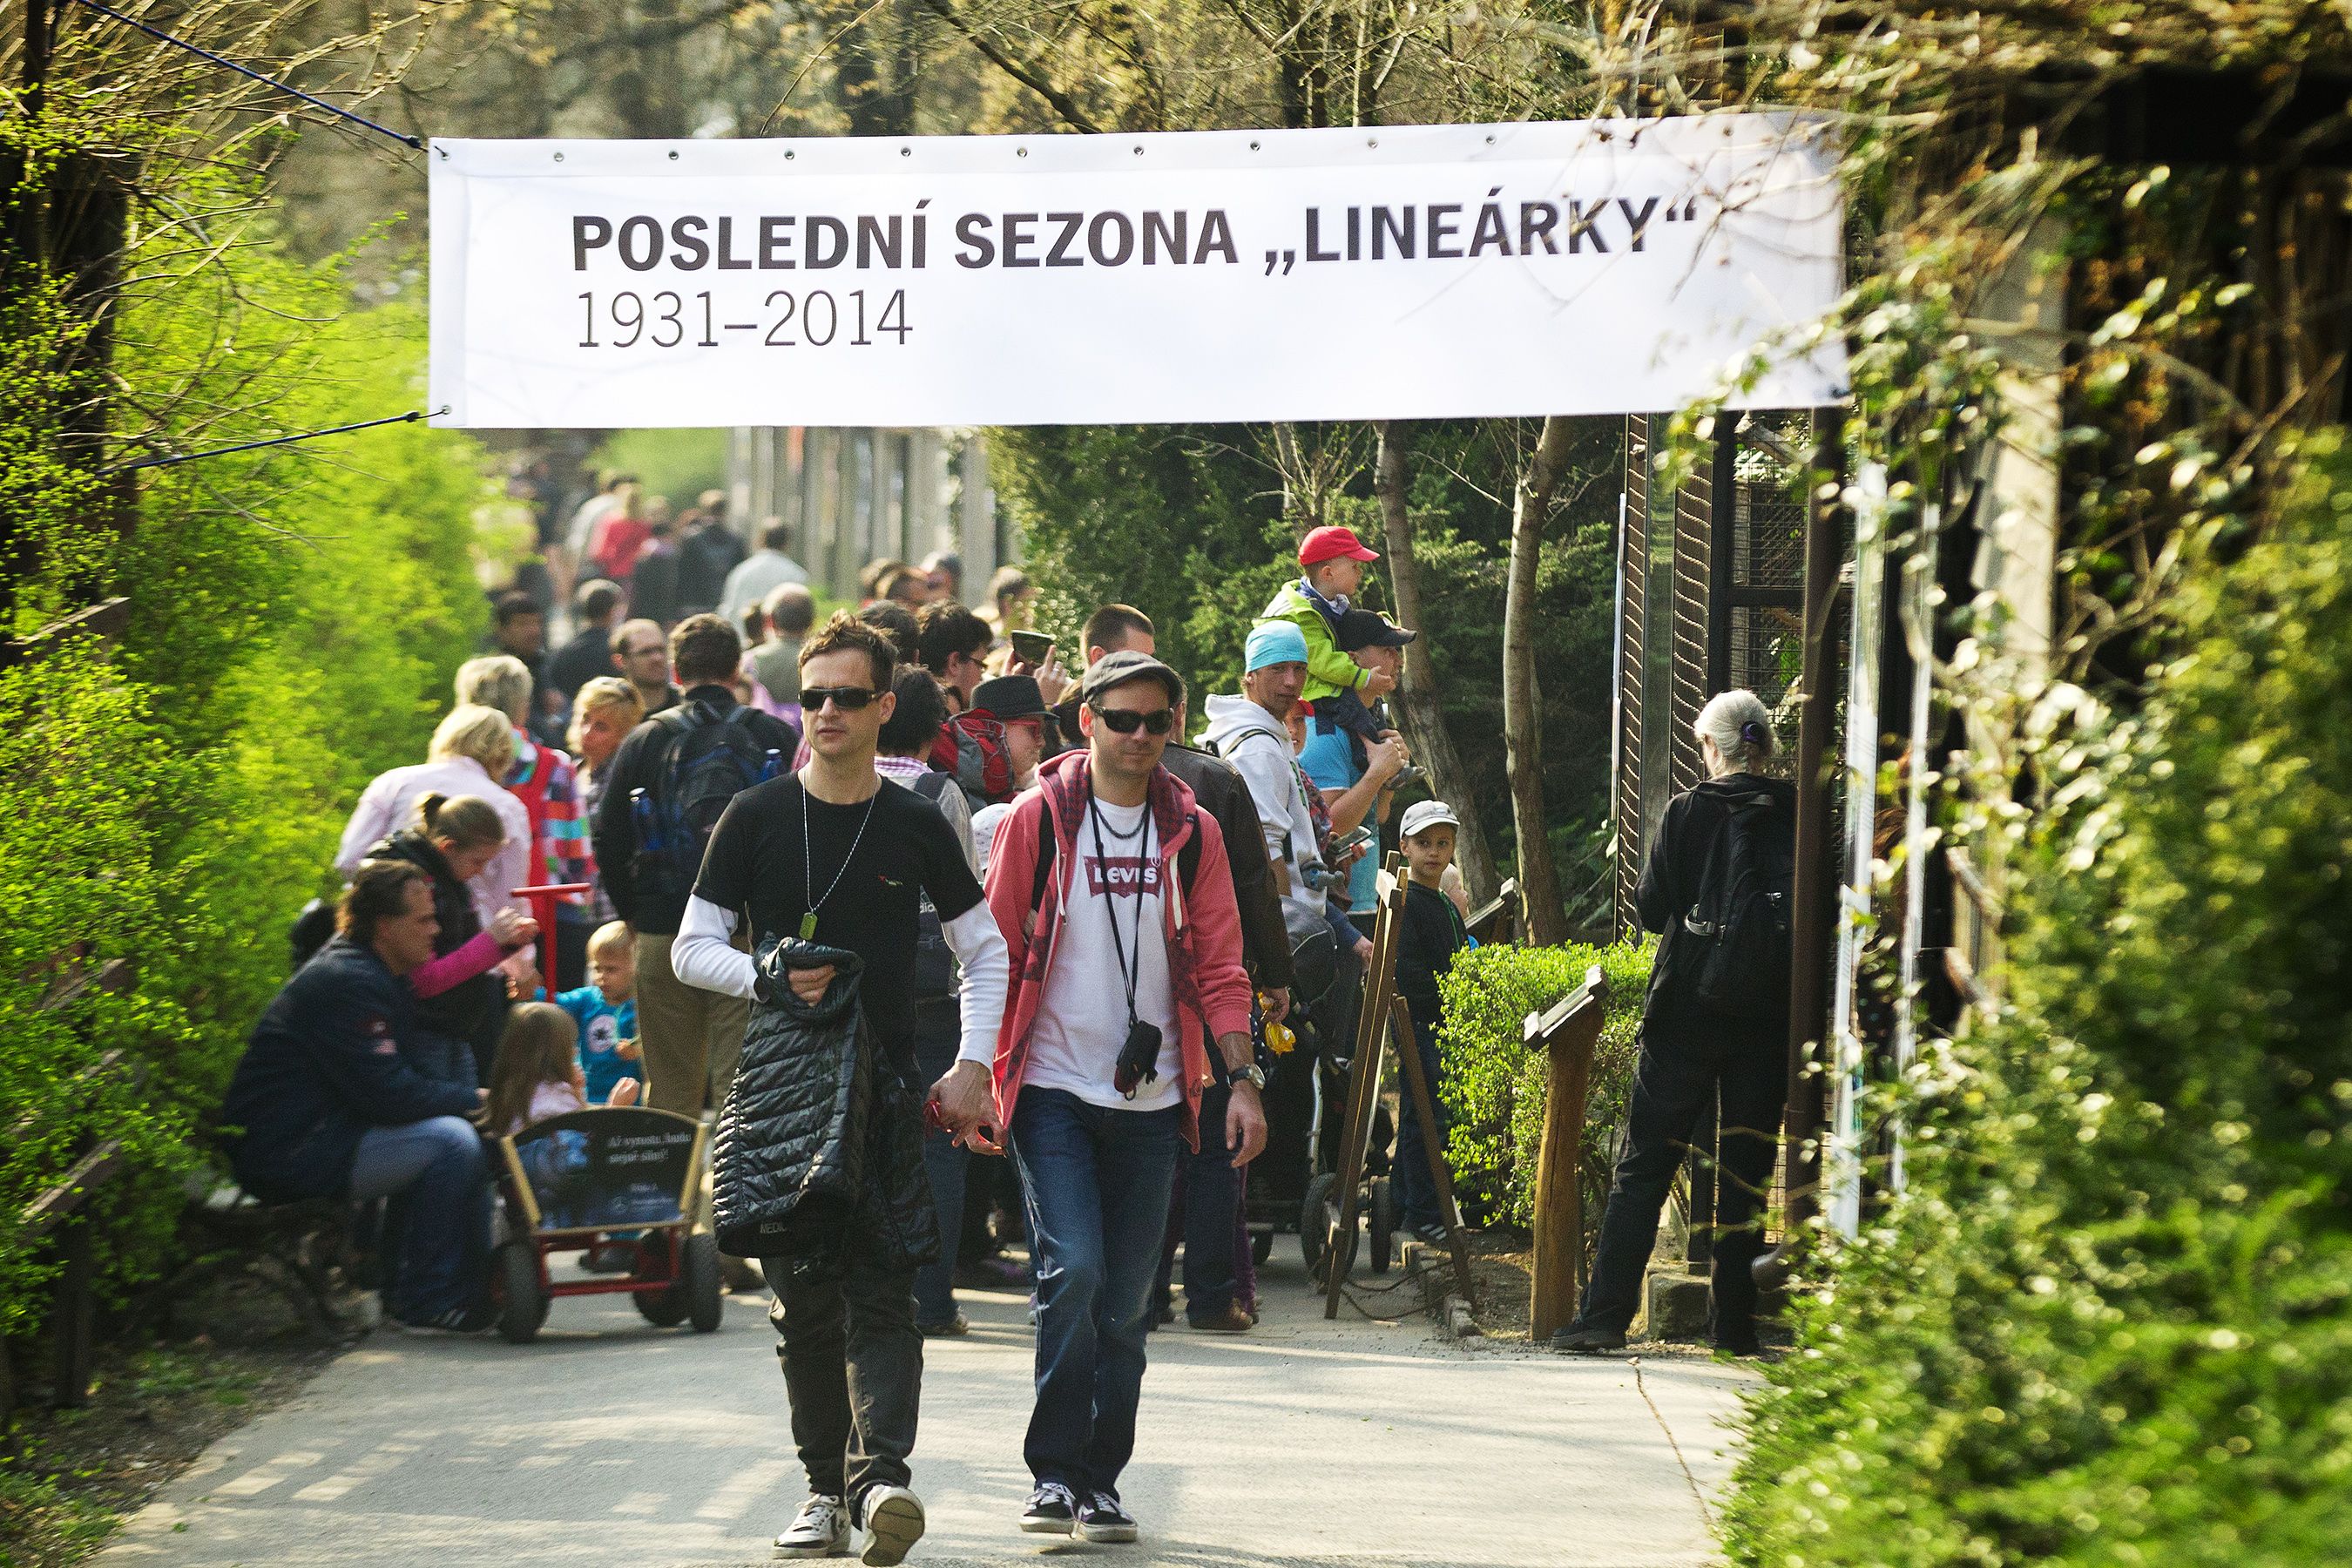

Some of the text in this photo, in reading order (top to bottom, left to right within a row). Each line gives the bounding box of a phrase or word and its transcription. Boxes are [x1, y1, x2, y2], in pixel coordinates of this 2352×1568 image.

[573, 198, 932, 271] POSLEDNÍ
[955, 209, 1240, 269] SEZONA
[578, 288, 913, 348] 1931–2014
